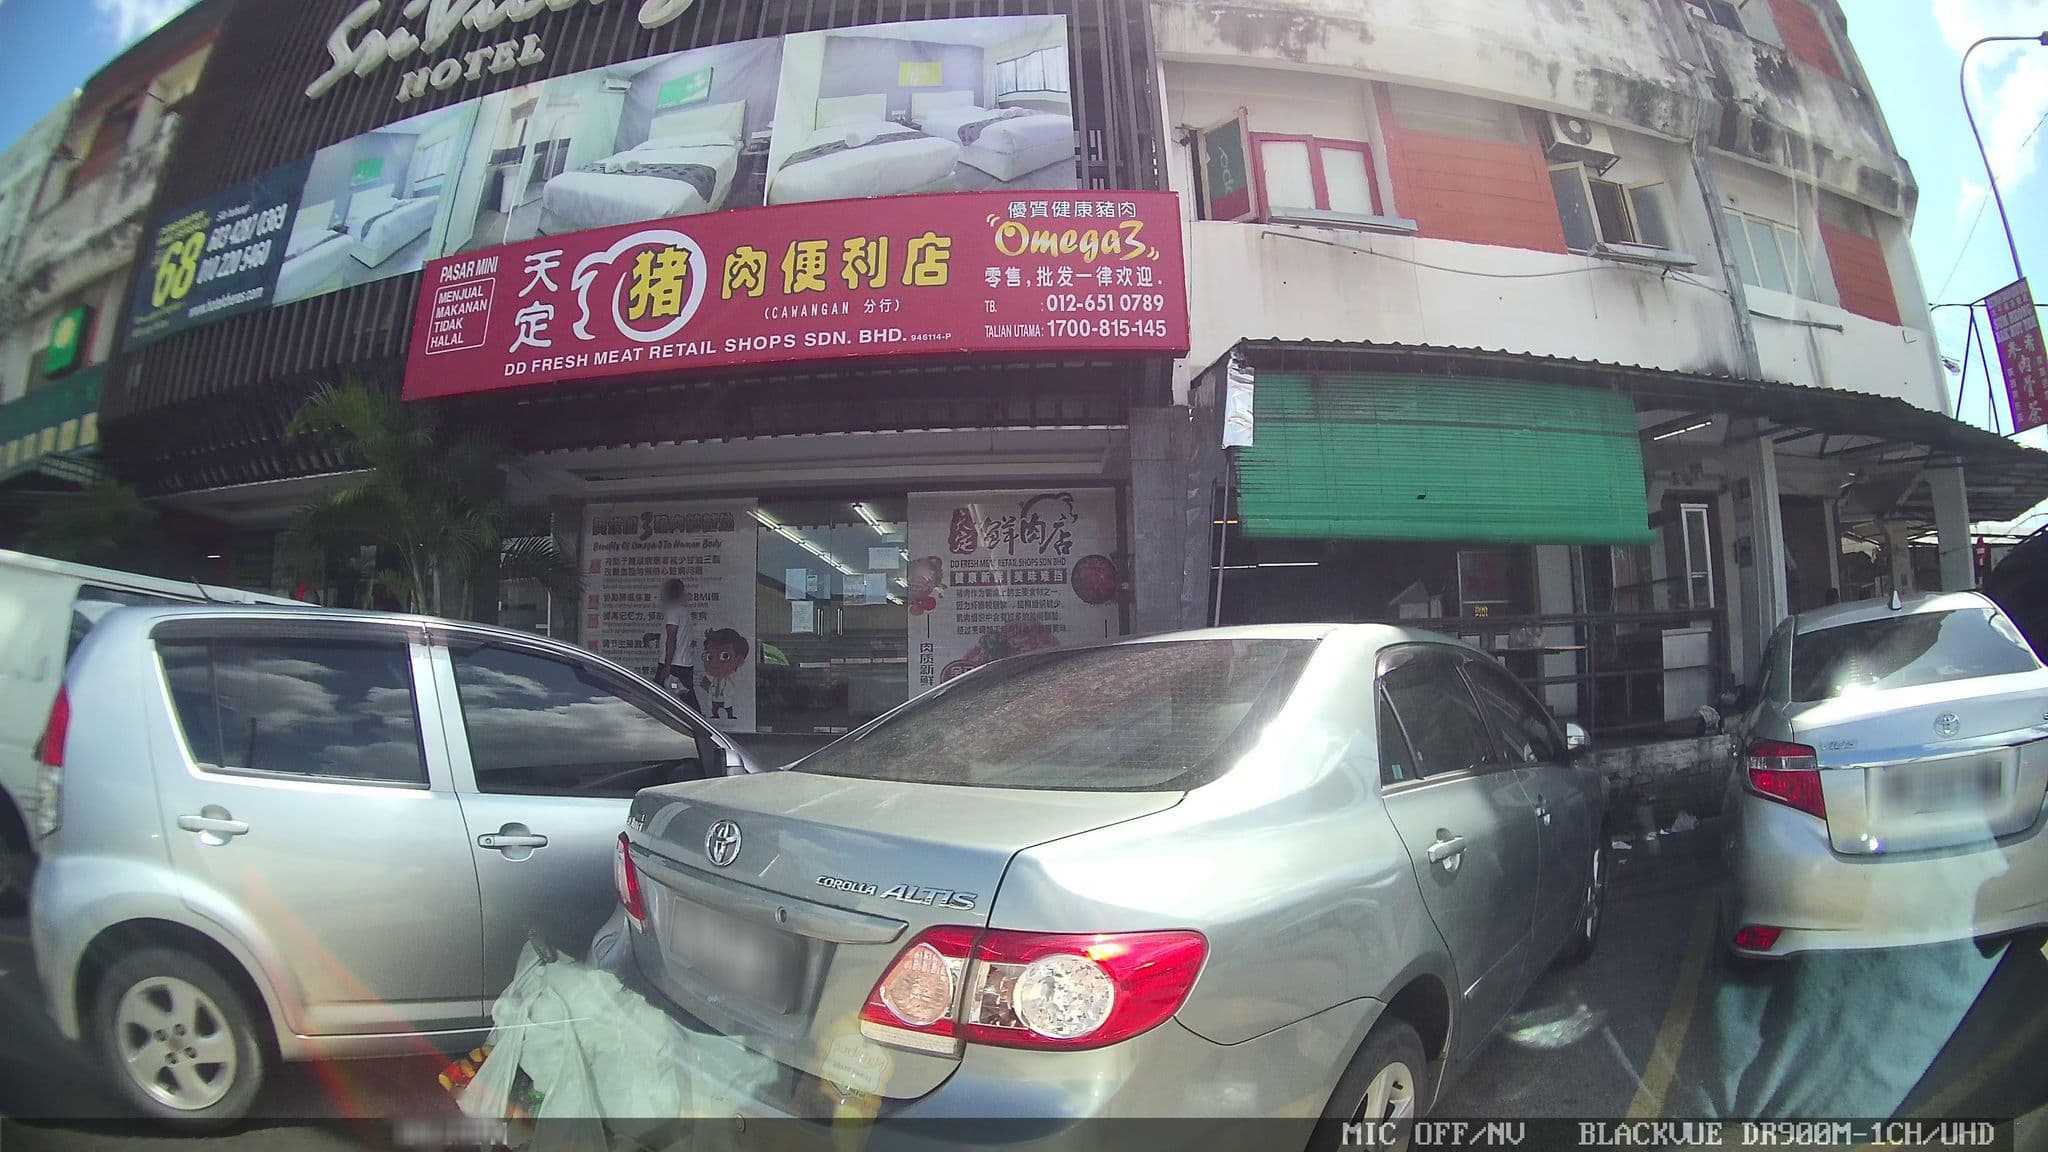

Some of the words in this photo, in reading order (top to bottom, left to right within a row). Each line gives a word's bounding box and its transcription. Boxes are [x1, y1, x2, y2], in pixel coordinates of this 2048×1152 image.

[395, 33, 546, 102] HOTEL
[1007, 200, 1137, 219] 優質健康豬肉
[152, 231, 206, 307] 68
[440, 261, 475, 283] PASAR
[476, 256, 499, 277] MINI
[438, 285, 484, 304] MENJUAL
[509, 249, 564, 353] 天定
[1119, 294, 1164, 312] 0789
[435, 299, 488, 319] MAKANAN
[433, 317, 464, 333] TIDAK
[984, 325, 1012, 338] TALIAN
[1046, 319, 1167, 337] 1700-815-145
[430, 333, 464, 349] HALAL
[504, 361, 526, 377] DD
[530, 352, 589, 374] FRESH
[593, 347, 644, 366] MEAT
[649, 341, 717, 360] RETAIL
[724, 333, 796, 354] SHOPS
[804, 330, 852, 348] SDN.
[858, 327, 908, 344] BHD.
[910, 332, 952, 342] 946114-P
[702, 538, 722, 548] Body
[961, 560, 979, 568] FRESH
[980, 560, 997, 568] MEA
[1019, 558, 1038, 567] SHOPS
[920, 643, 934, 686] 肉质新鲜
[815, 875, 878, 896] COROLLA
[880, 884, 978, 911] ALTIS
